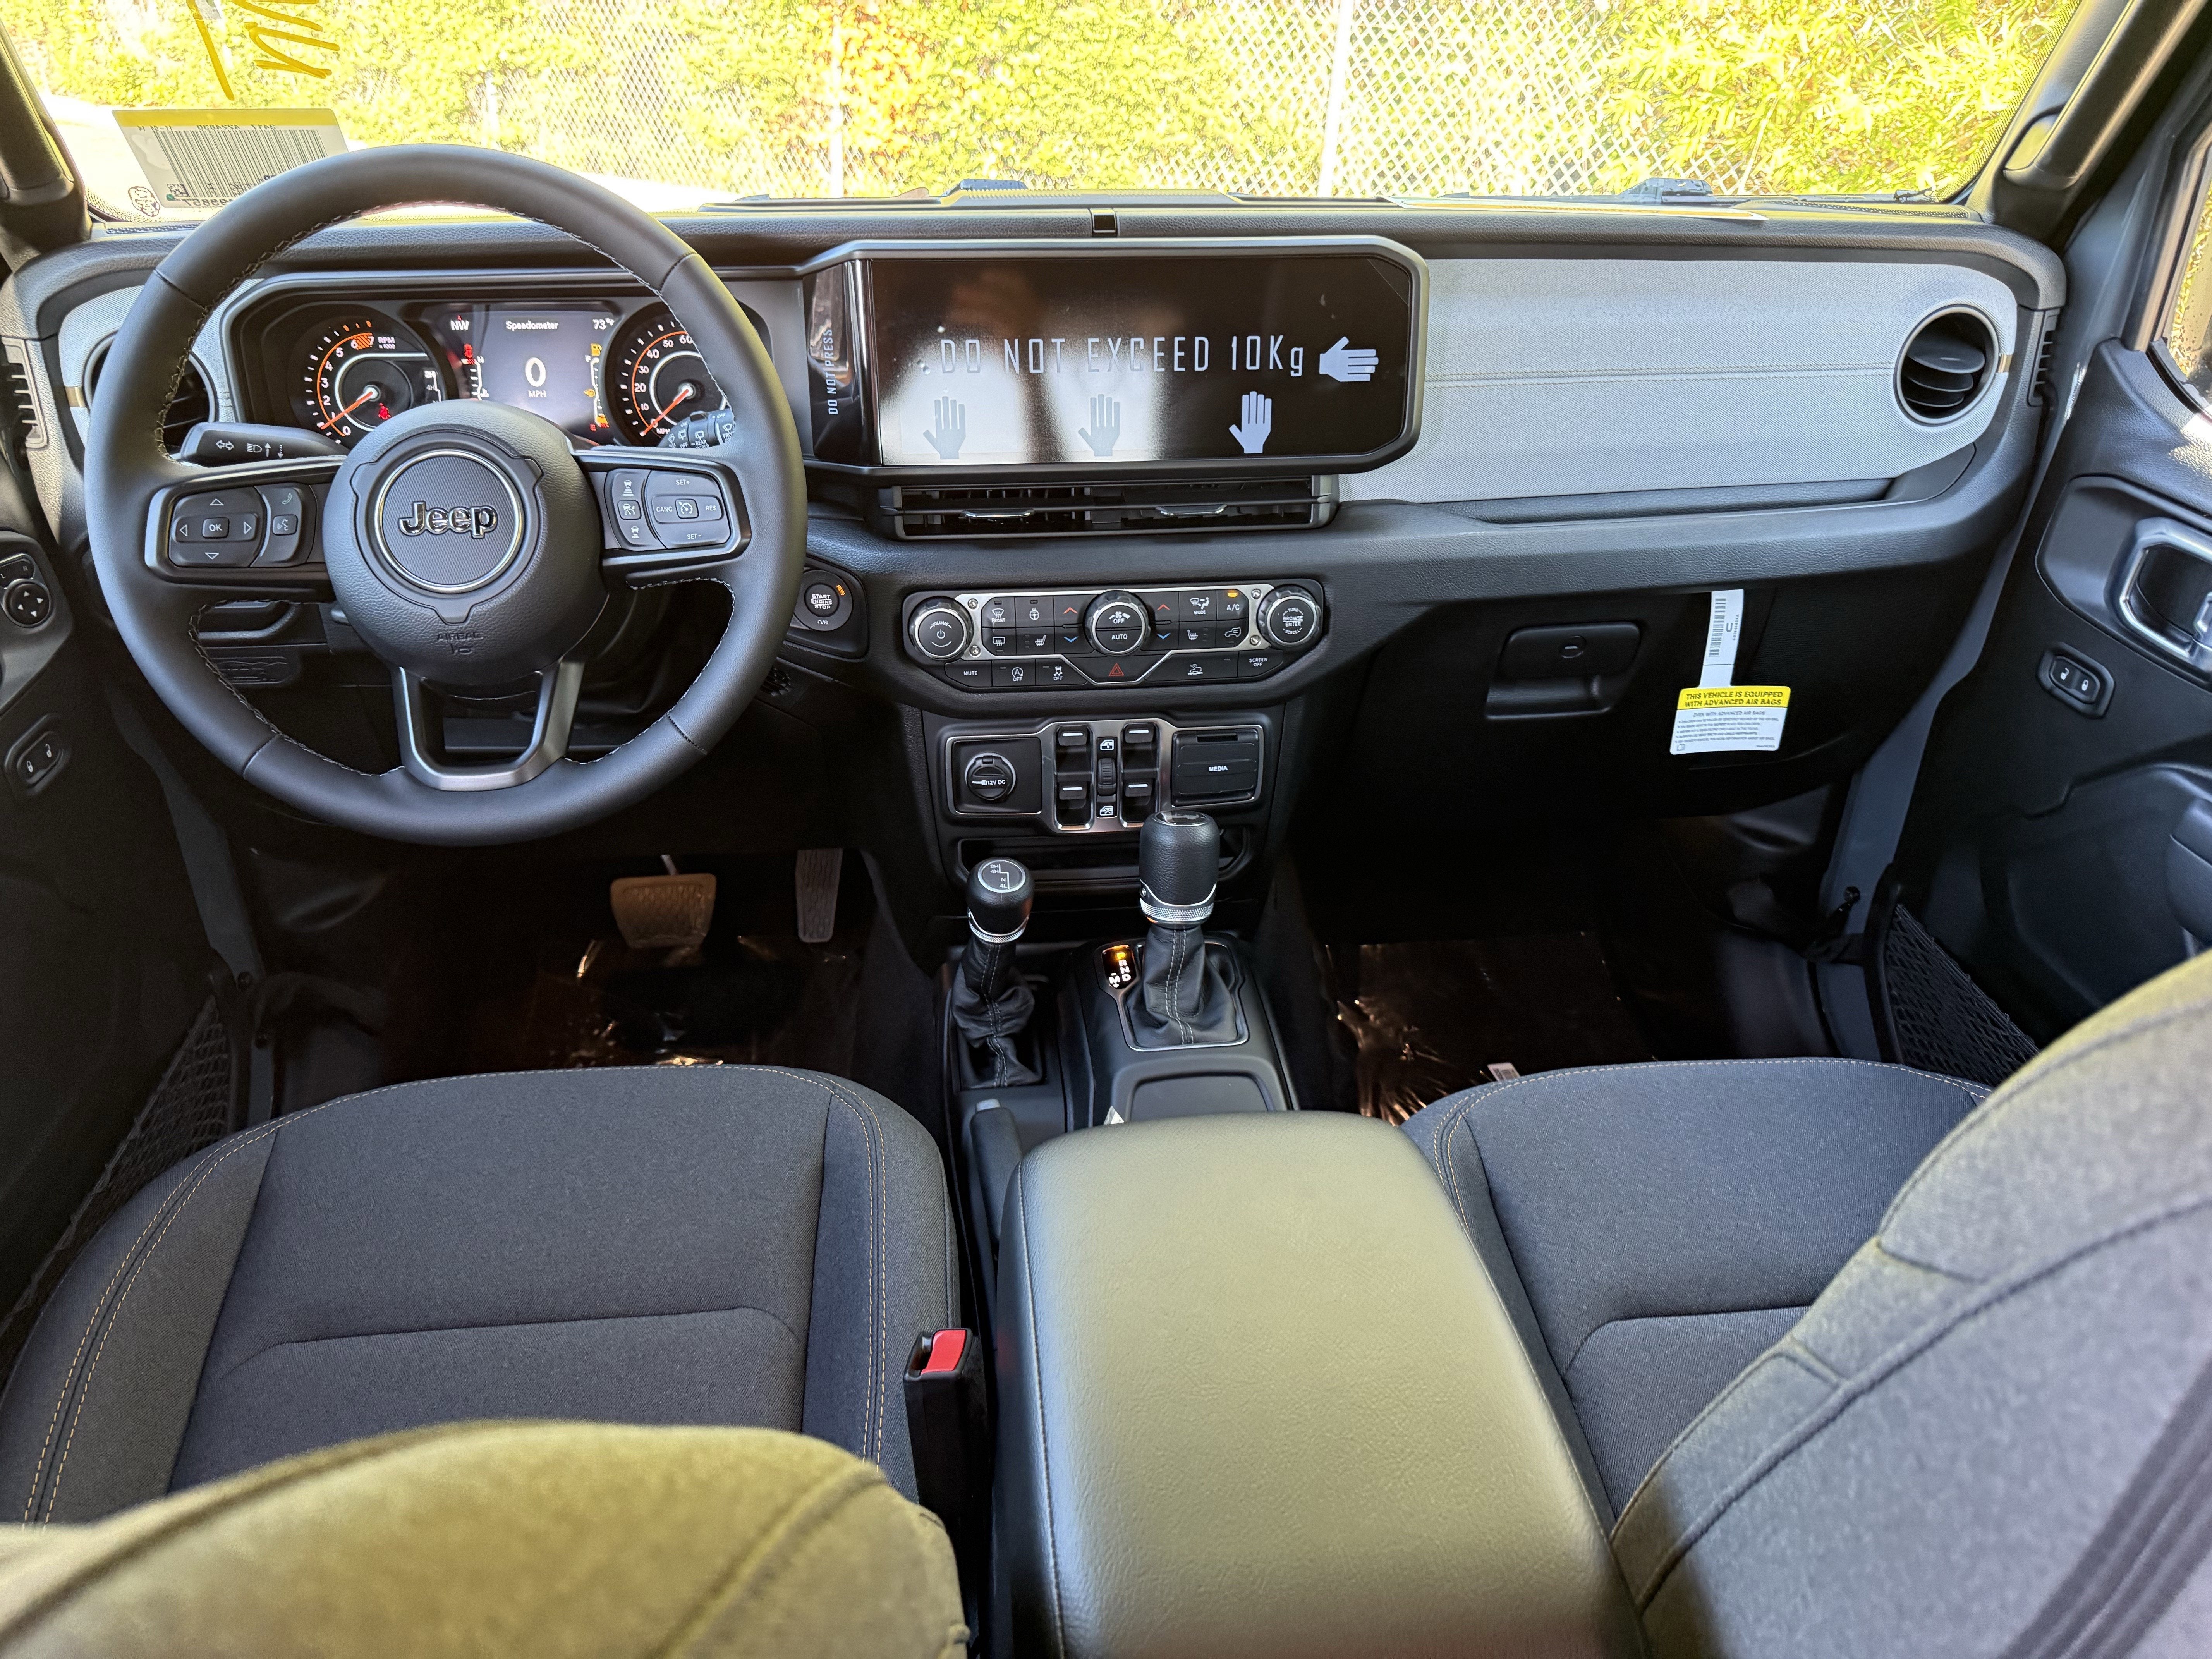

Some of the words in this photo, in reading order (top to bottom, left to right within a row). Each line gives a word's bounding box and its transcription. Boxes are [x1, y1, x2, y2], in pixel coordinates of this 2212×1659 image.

[450, 320, 469, 330] NW
[505, 320, 559, 331] Speedometer
[351, 339, 358, 349] 6
[663, 340, 674, 348] 50
[823, 329, 835, 367] PRESS
[336, 347, 344, 357] 5
[646, 349, 659, 359] 40
[941, 339, 981, 374] DO
[1004, 338, 1065, 374] NOT
[1087, 336, 1209, 372] EXCEED
[1231, 335, 1304, 377] 10Kg
[325, 361, 333, 371] 4
[638, 366, 649, 374] 30
[525, 357, 546, 387] 0
[321, 378, 329, 388] 3
[634, 383, 646, 393] 20
[826, 372, 837, 394] NOT
[323, 395, 331, 405] 2
[641, 403, 649, 411] 10
[828, 399, 838, 414] DO
[342, 426, 351, 436] 0
[397, 500, 498, 539] Jeep
[1120, 966, 1130, 974] N
[1109, 975, 1120, 984] M
